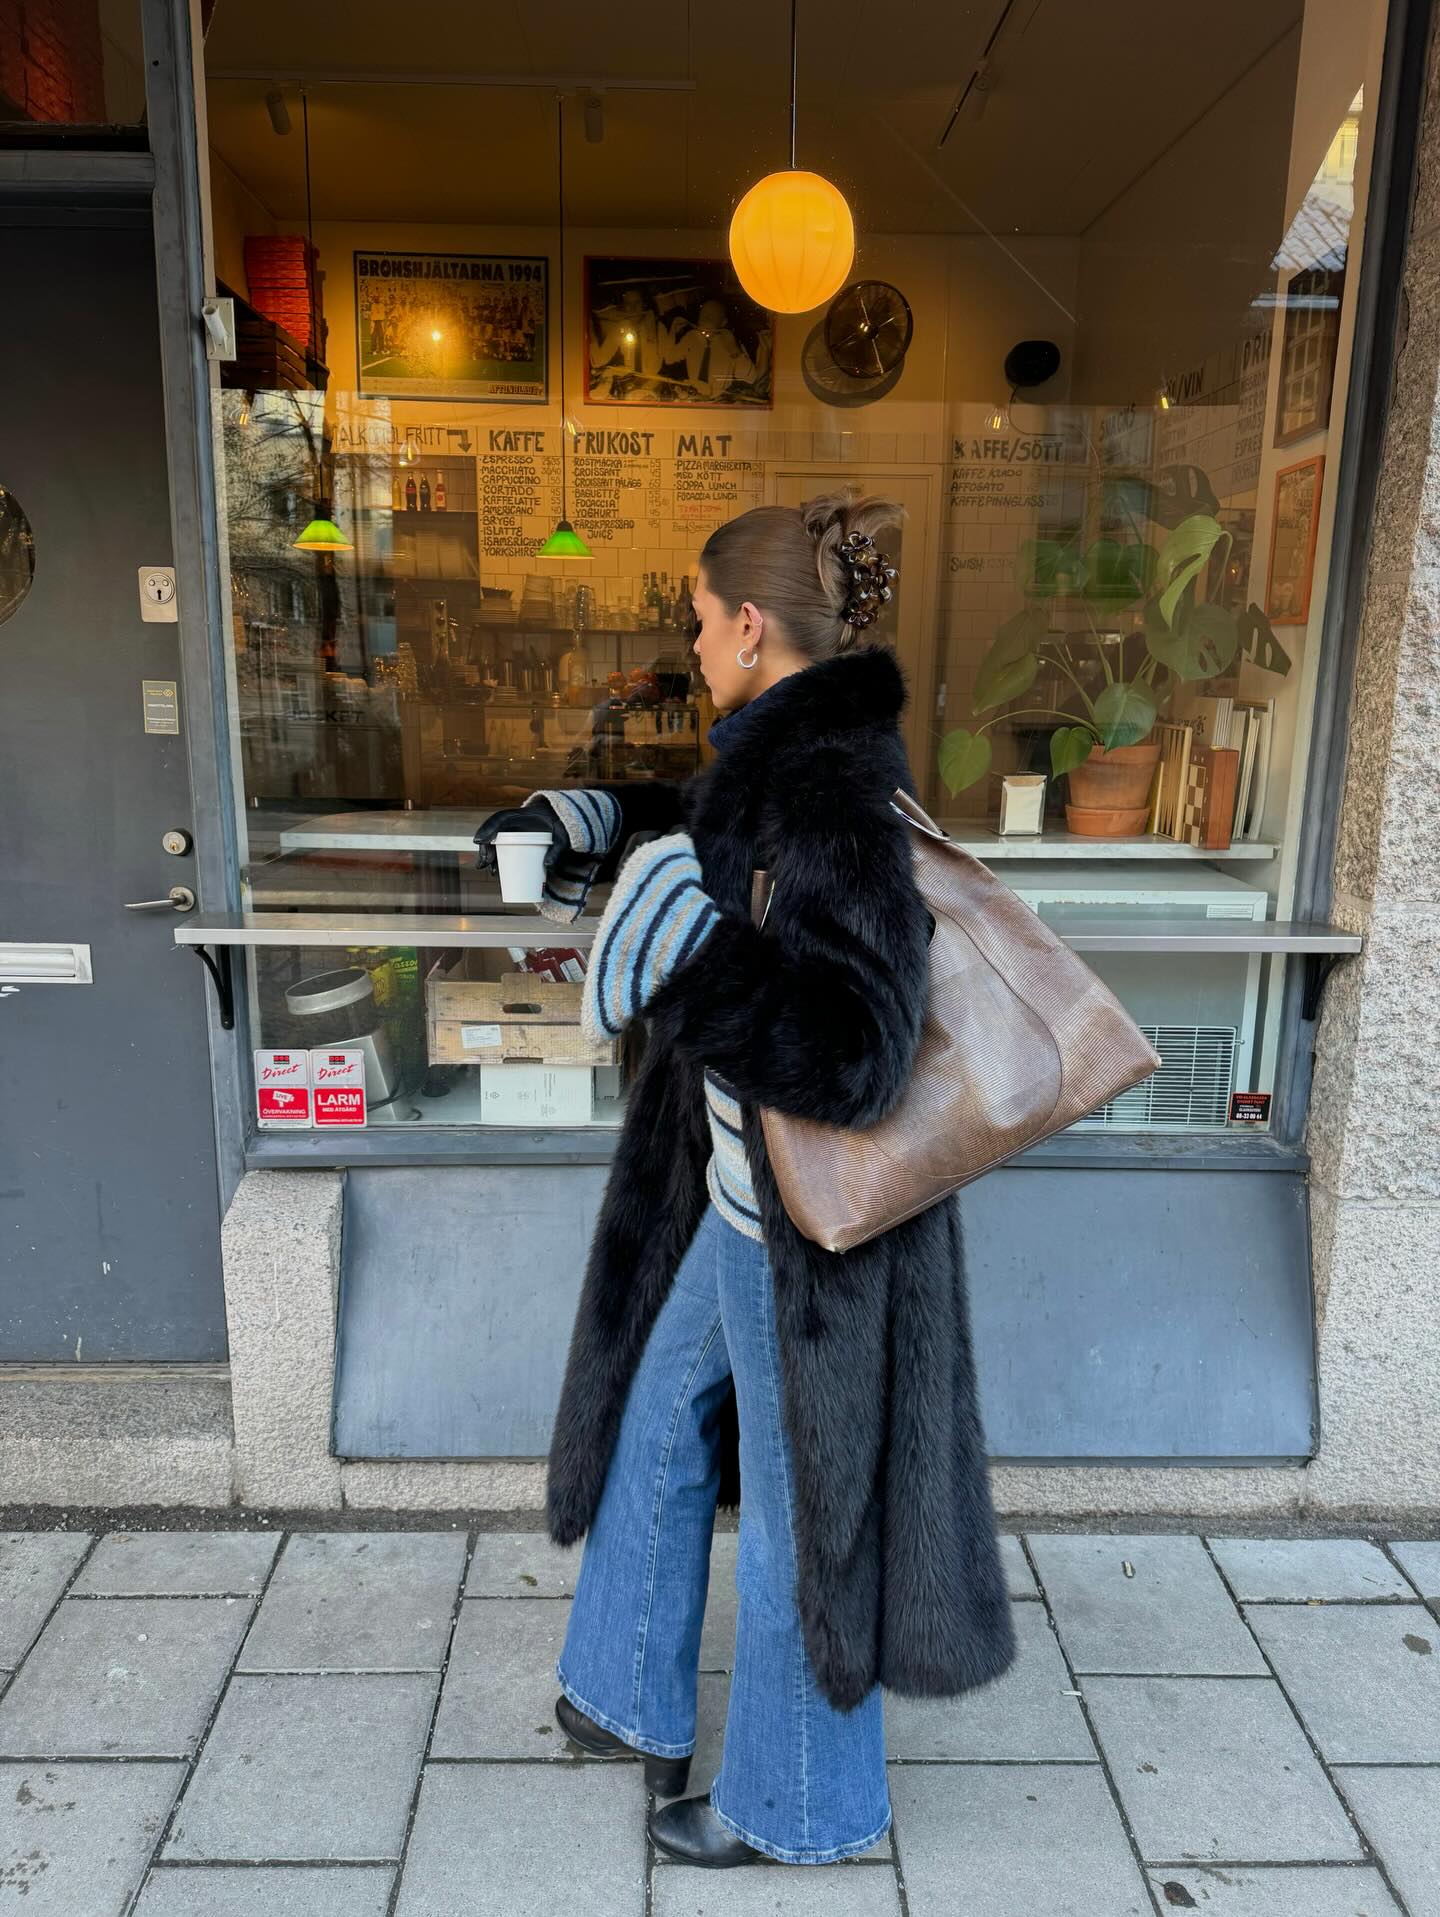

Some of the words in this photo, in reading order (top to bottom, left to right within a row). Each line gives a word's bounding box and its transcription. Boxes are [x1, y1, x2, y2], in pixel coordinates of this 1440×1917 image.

[509, 264, 542, 282] 1994
[489, 429, 545, 452] KAFFE
[574, 431, 655, 456] FRUKOST
[677, 434, 733, 457] MAT
[482, 455, 533, 464] ESPRESSO
[481, 466, 536, 475] MACCHIATO
[676, 460, 702, 471] PIZZA
[574, 467, 621, 477] CROISSANT
[676, 471, 693, 479] MED
[697, 471, 724, 481] KÖTT
[482, 475, 541, 485] CAPPUCCINO
[574, 477, 613, 488] CROISSANT
[676, 480, 704, 490] SOPPA
[708, 481, 736, 490] LUNCH
[483, 485, 534, 496] CORTADO
[951, 482, 1005, 492] AFFOGATO
[575, 488, 620, 499] BAGUETTE
[713, 492, 737, 501] LUNCH
[575, 499, 616, 508] FOCACCIA
[483, 505, 534, 515] AMERICANO
[575, 508, 619, 518] YOGHURT
[587, 529, 613, 540] JUICE
[262, 1063, 303, 1080] Direct
[318, 1063, 359, 1080] Direct
[317, 1094, 361, 1106] LARM
[263, 1107, 306, 1115] ÖVERVAKNING
